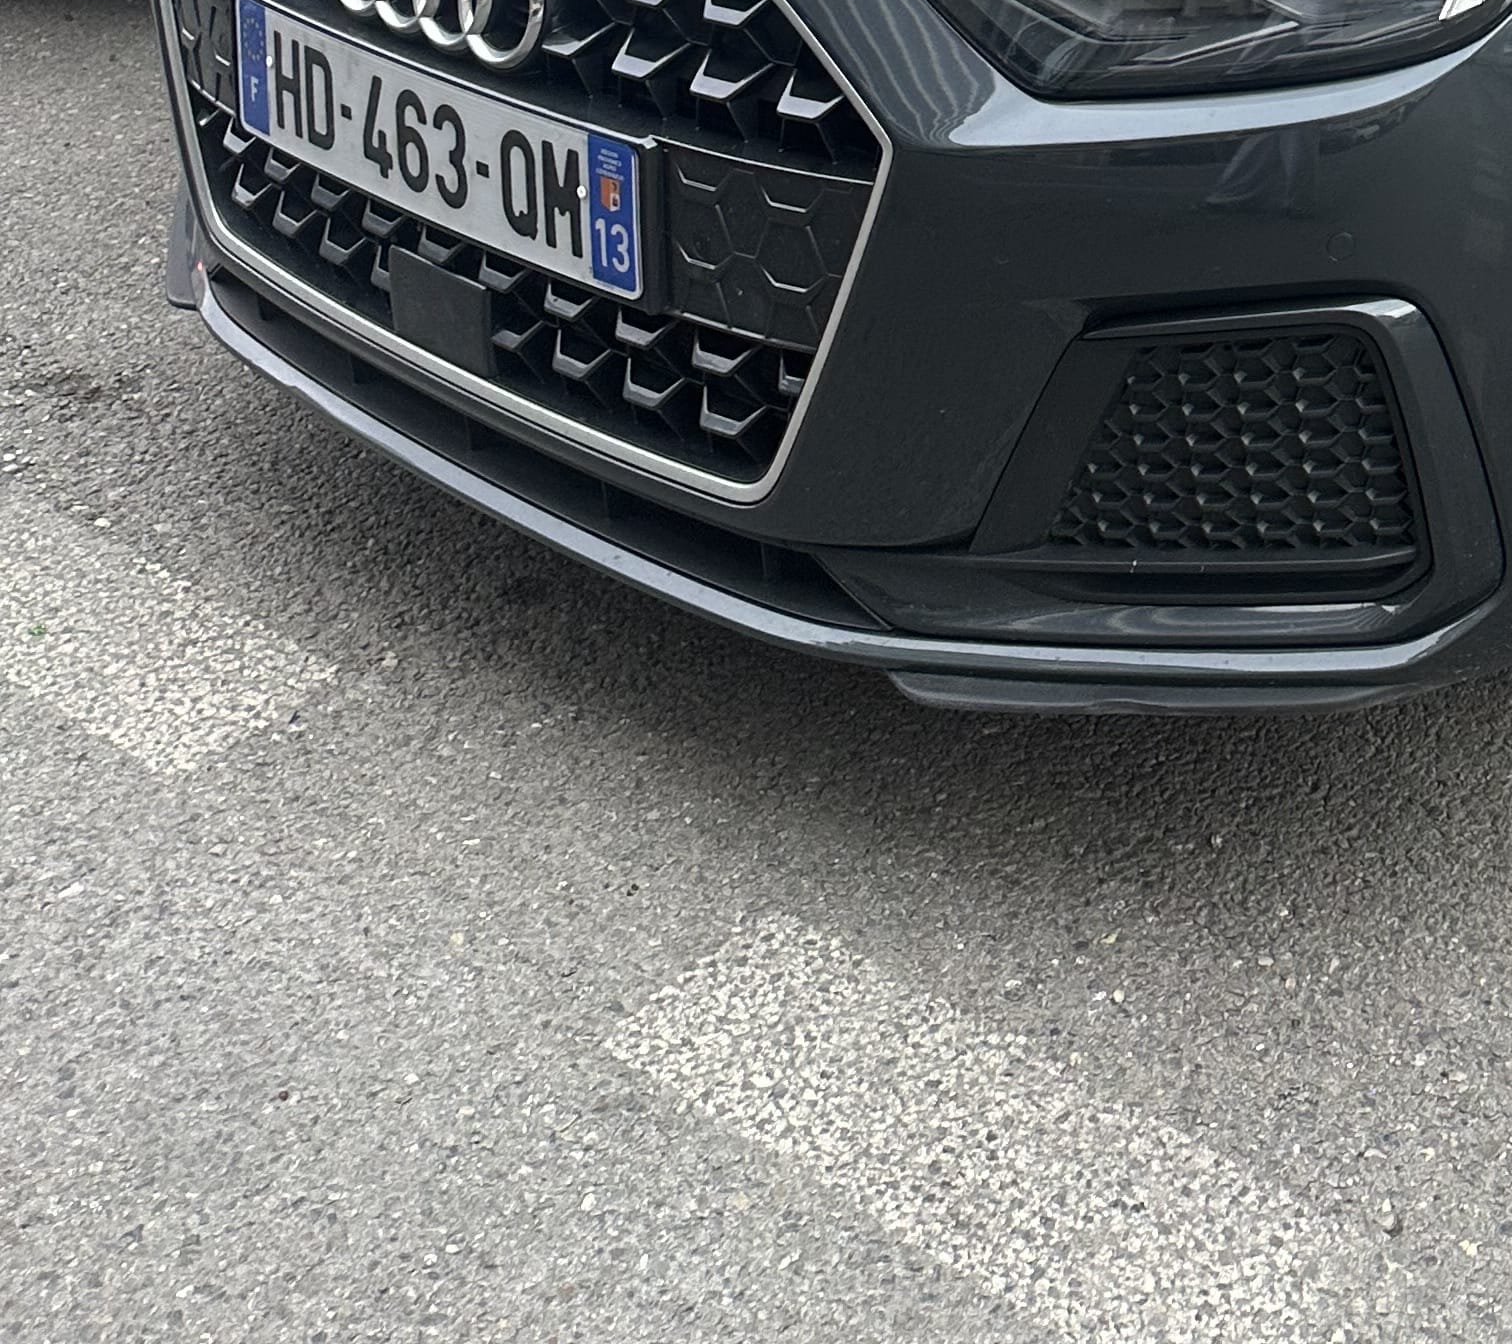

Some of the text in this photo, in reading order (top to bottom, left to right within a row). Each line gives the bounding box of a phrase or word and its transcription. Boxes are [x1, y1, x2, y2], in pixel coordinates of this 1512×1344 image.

[250, 75, 259, 103] F
[273, 29, 584, 259] HD-463-QM
[594, 217, 631, 274] 13
